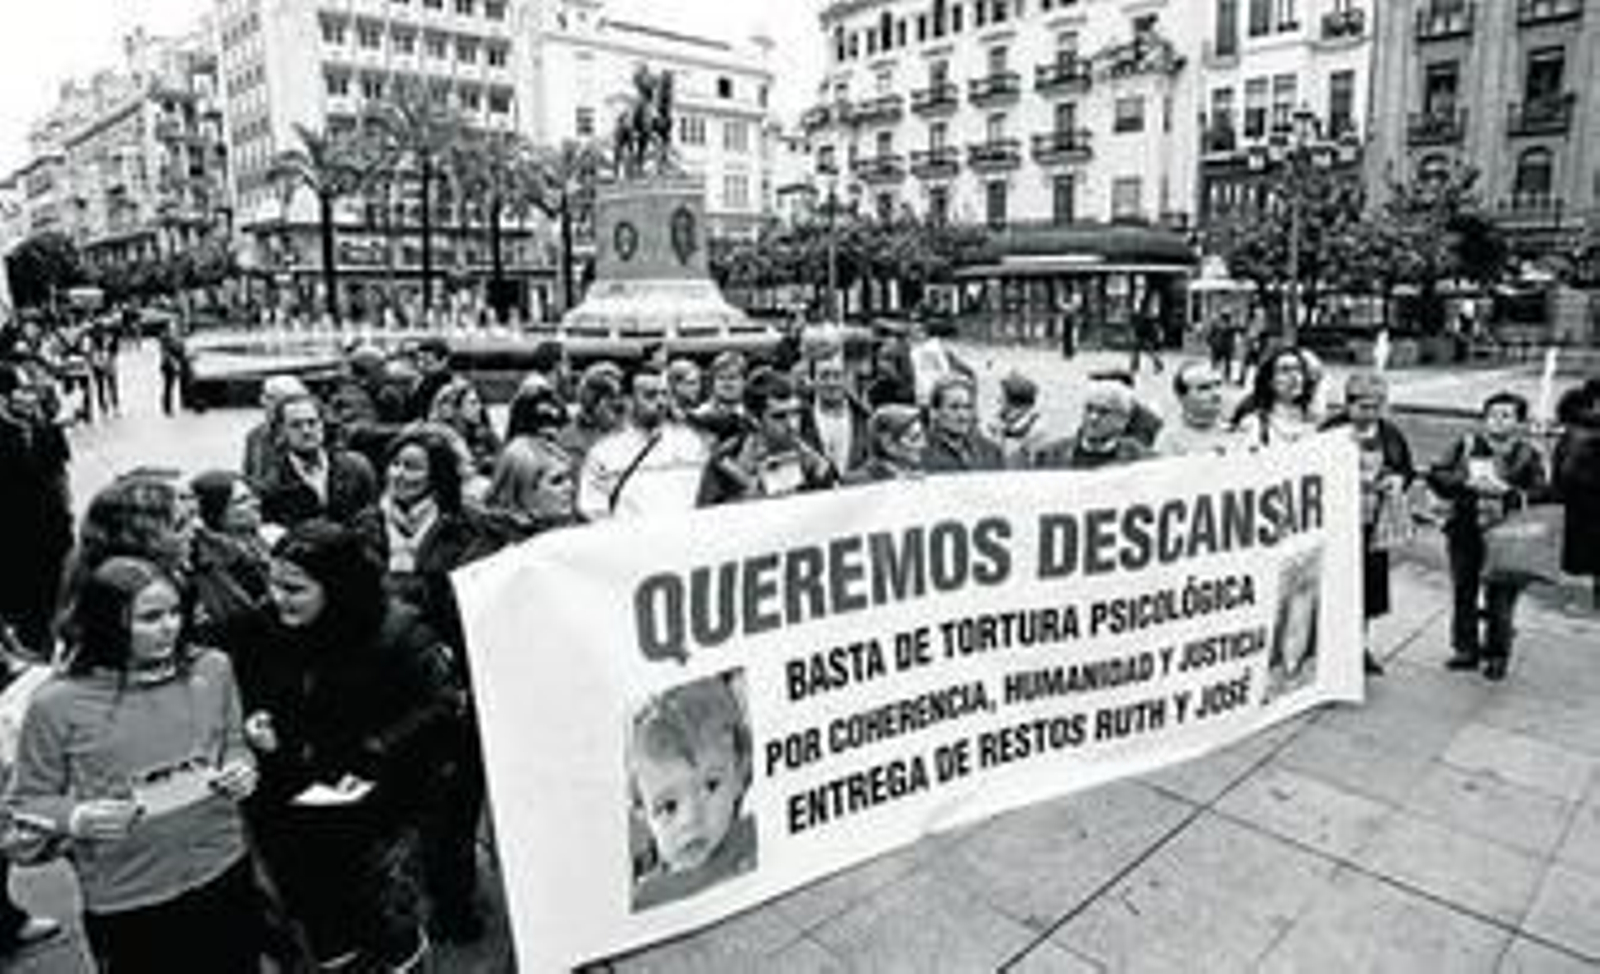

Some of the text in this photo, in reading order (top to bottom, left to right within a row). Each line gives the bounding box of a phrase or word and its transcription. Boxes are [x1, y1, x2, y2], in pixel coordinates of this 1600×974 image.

[634, 475, 1322, 666] QUEREMOS DESCANSAR
[787, 575, 1255, 701] BASTA DE TORTURA PSICOLÓGICA
[766, 728, 822, 776] POR
[829, 681, 997, 753] COHERENCIA,
[1005, 652, 1154, 703] HUMANIDAD
[1160, 647, 1174, 676] Y
[788, 667, 1251, 834] ENTREGA DE RESTOS RUTH Y JOSÉ
